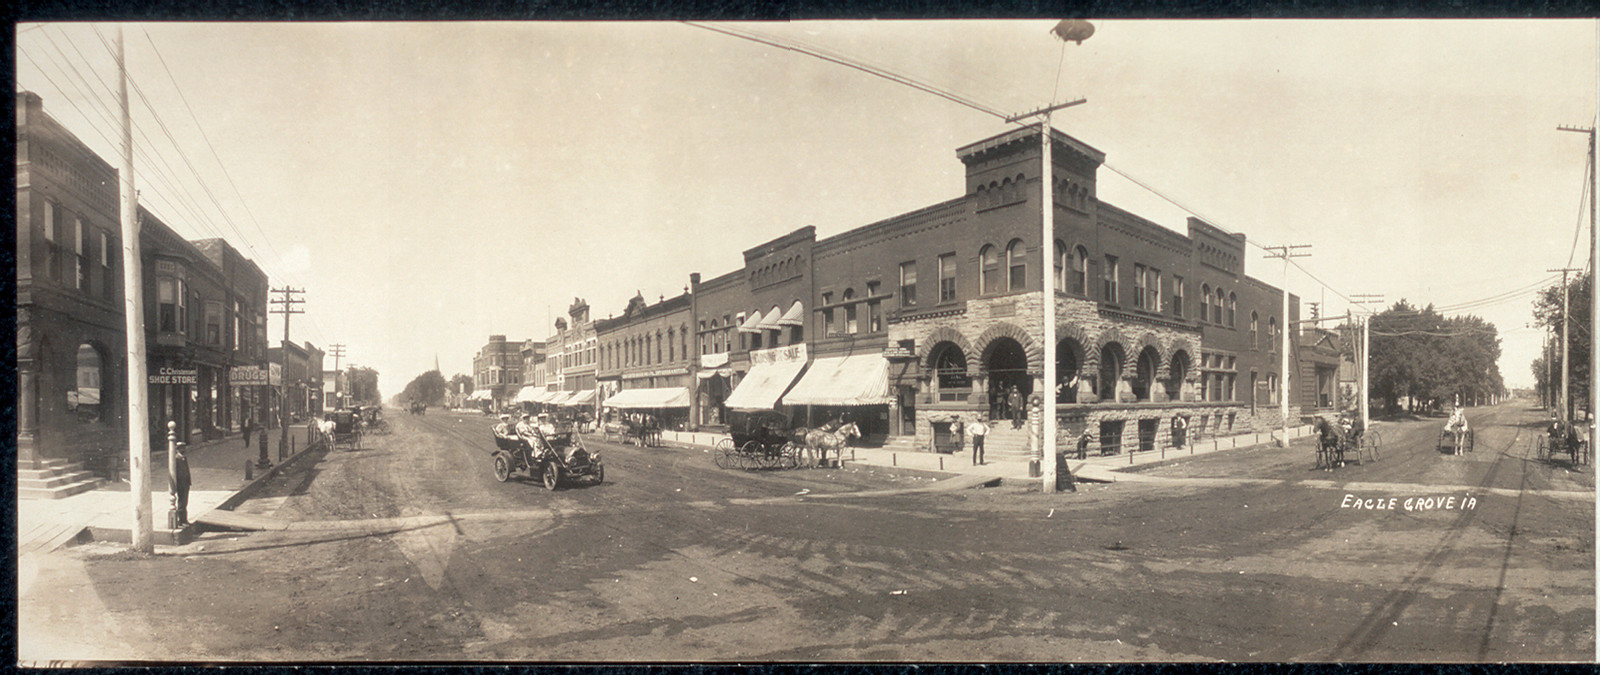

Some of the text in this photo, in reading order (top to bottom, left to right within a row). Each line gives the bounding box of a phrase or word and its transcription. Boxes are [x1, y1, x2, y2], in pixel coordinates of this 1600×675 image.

[783, 346, 801, 360] SALE
[149, 375, 197, 384] SHOE STORE
[231, 371, 266, 380] DRUGS
